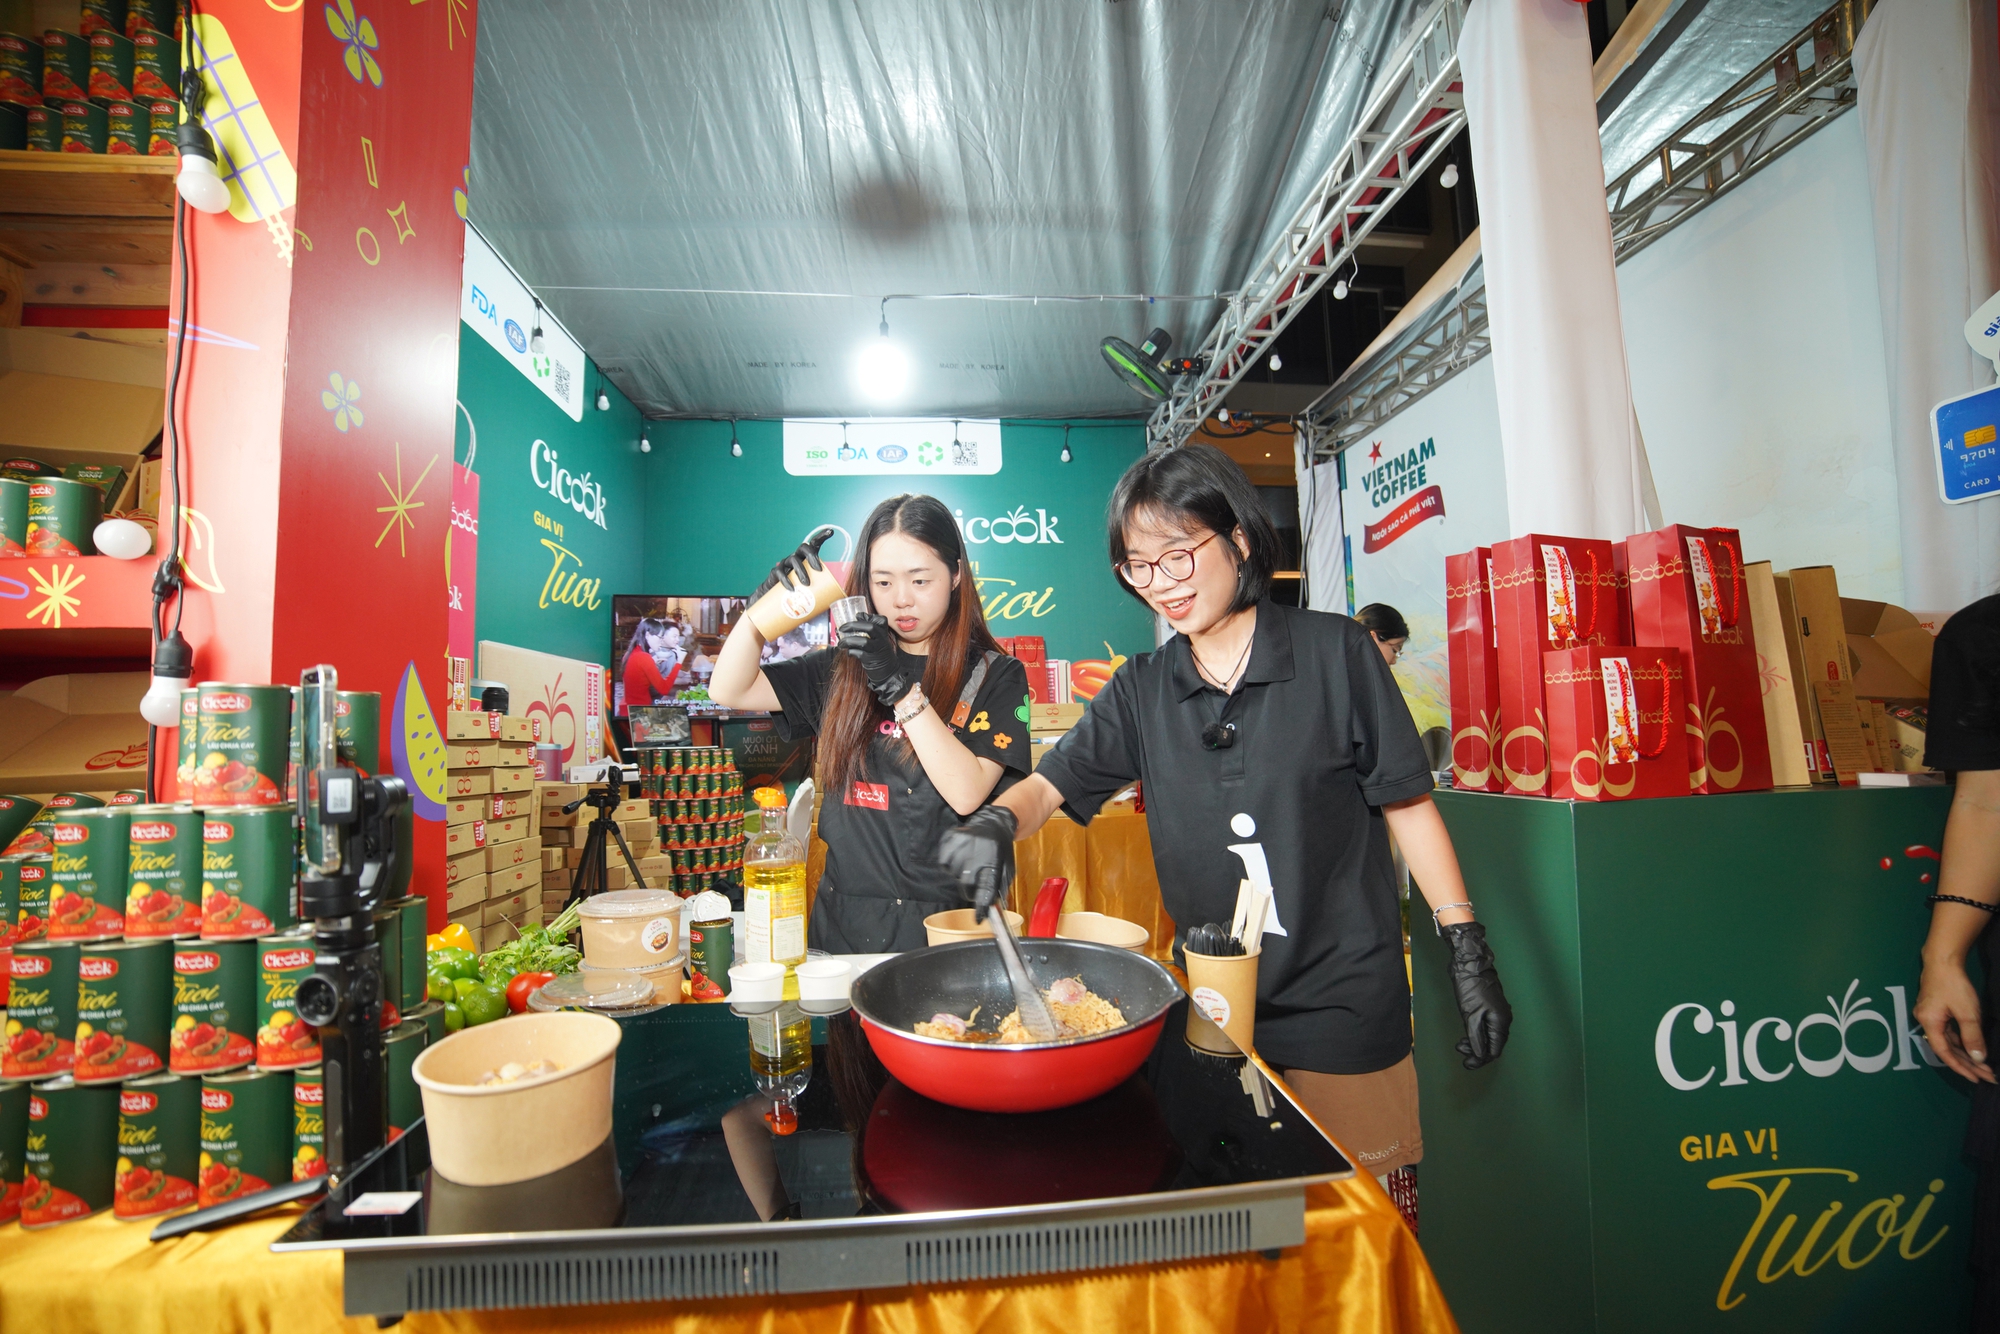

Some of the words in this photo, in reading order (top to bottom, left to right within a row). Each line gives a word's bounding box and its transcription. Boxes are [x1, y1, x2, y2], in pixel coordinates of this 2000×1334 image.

[471, 284, 498, 326] FDA
[508, 325, 524, 346] IAF
[806, 450, 828, 459] ISO
[884, 450, 902, 458] IAF
[1960, 447, 1996, 462] 9704
[1361, 436, 1436, 493] VIETNAM
[530, 439, 608, 530] Cicook
[1372, 464, 1427, 508] COFFEE
[1964, 478, 1990, 489] CARD
[534, 510, 552, 532] GIA
[553, 520, 564, 542] VỊ
[955, 505, 1064, 544] icook
[1388, 520, 1400, 533] SAO
[1637, 709, 1674, 724] icook
[744, 744, 778, 755] XANH
[166, 870, 181, 878] CAY
[265, 952, 310, 967] Cicook
[37, 1006, 54, 1015] CAY
[106, 1008, 123, 1018] CAY
[209, 1001, 225, 1010] CAY
[1654, 979, 1946, 1091] Cicook
[1679, 1135, 1738, 1162] GIA
[1743, 1129, 1779, 1160] VỊ
